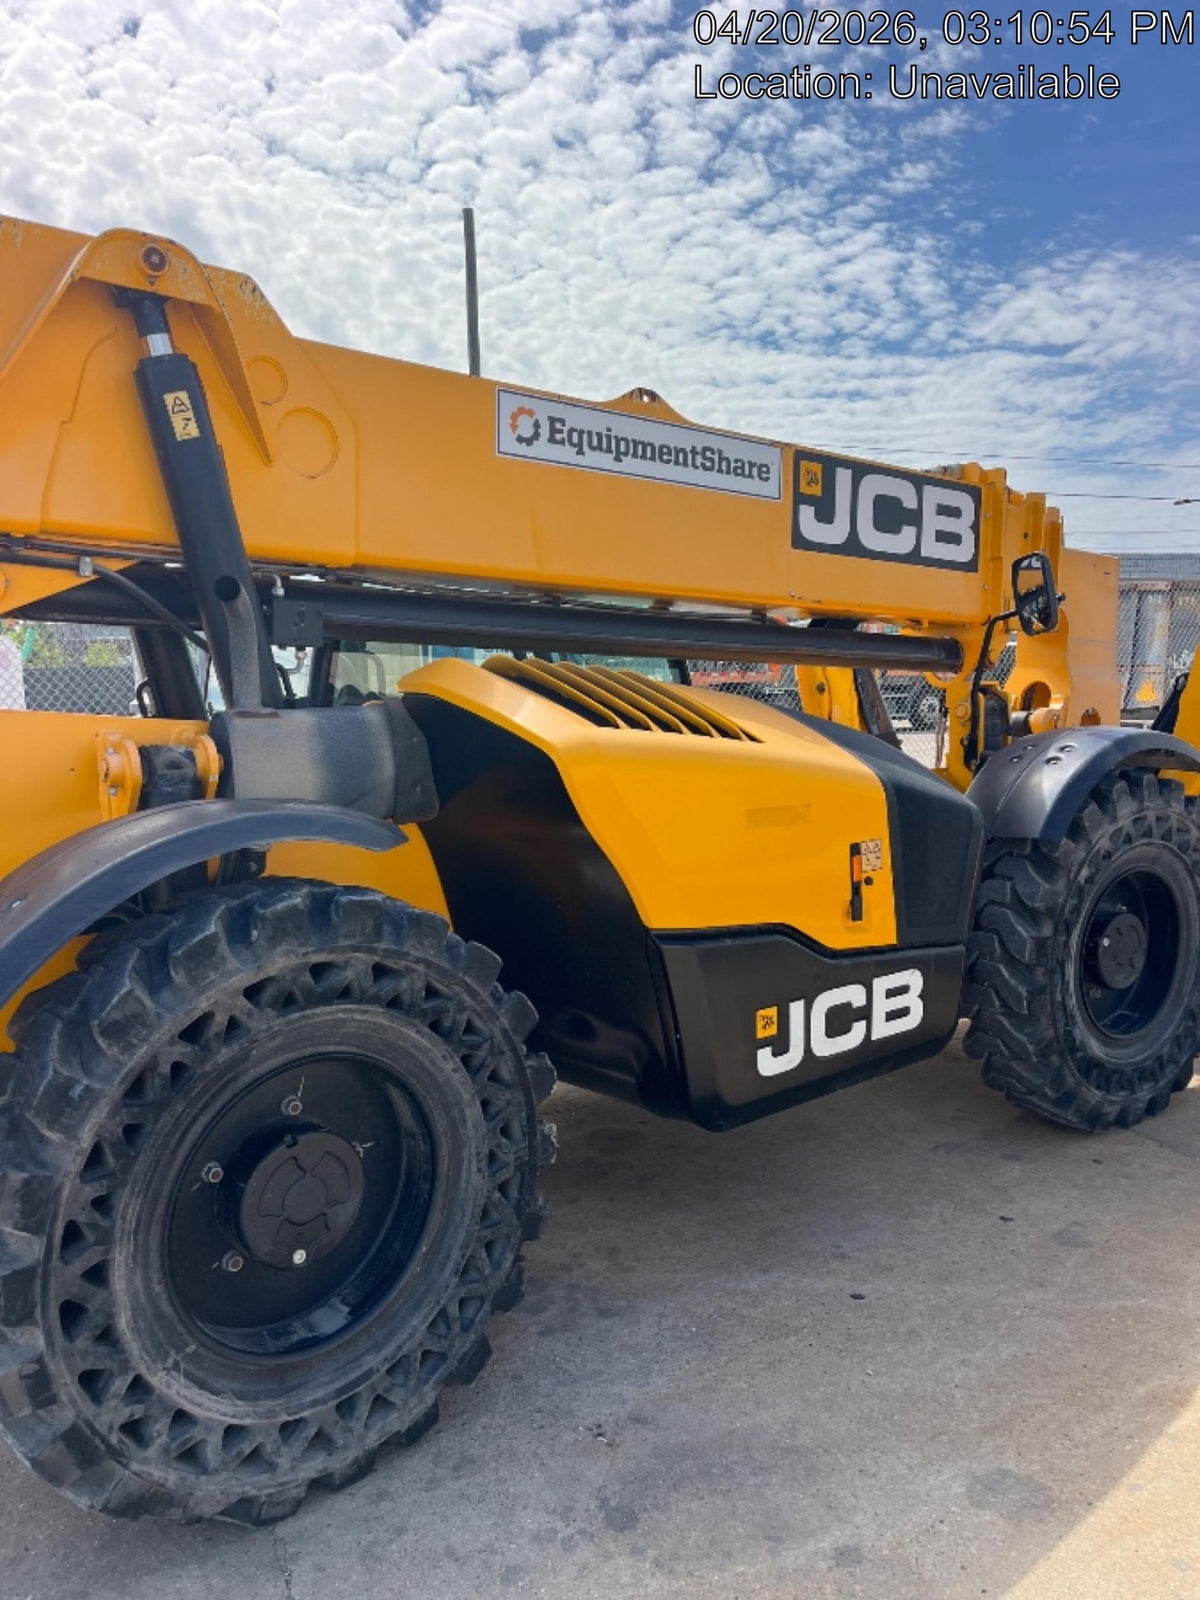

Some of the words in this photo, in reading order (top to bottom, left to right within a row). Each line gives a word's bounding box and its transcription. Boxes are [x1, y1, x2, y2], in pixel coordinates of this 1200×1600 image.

[547, 415, 771, 483] EquipmentShare
[799, 466, 976, 564] JCB
[757, 968, 924, 1077] JCB
